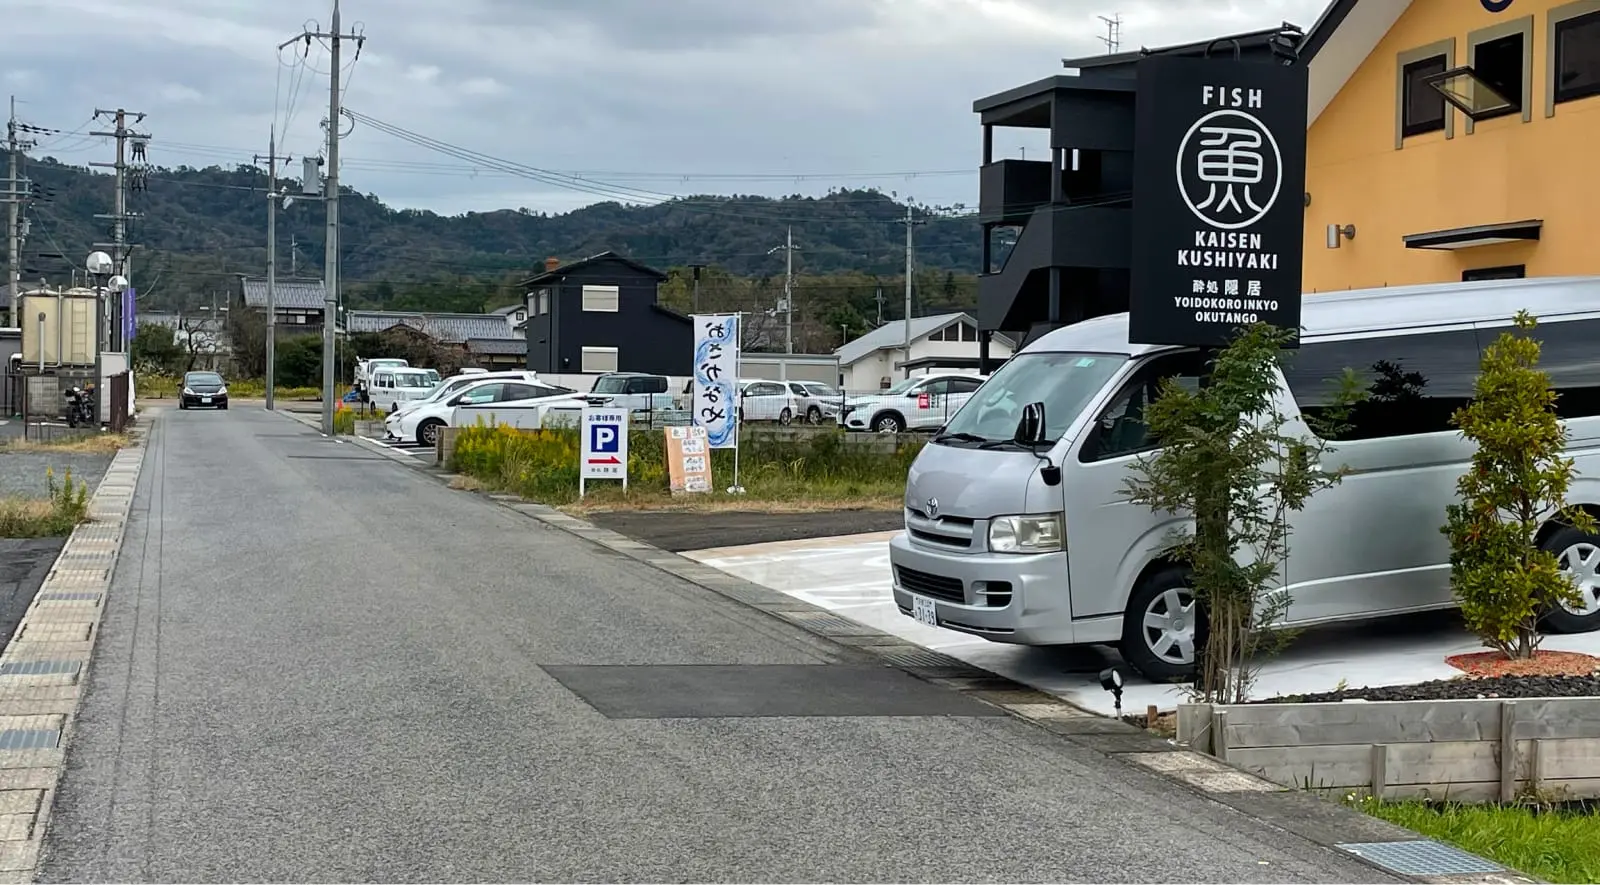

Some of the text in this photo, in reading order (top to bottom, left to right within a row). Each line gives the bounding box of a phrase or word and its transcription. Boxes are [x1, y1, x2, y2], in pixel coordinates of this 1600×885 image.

[1202, 85, 1262, 108] FISH
[1196, 126, 1263, 214] 魚
[1195, 231, 1261, 249] KAISEN
[1177, 250, 1277, 270] KUSHIYAKI
[1174, 296, 1278, 311] YOIDOKORO INKYO
[1195, 311, 1257, 323] OKUTANGO
[596, 427, 614, 450] P
